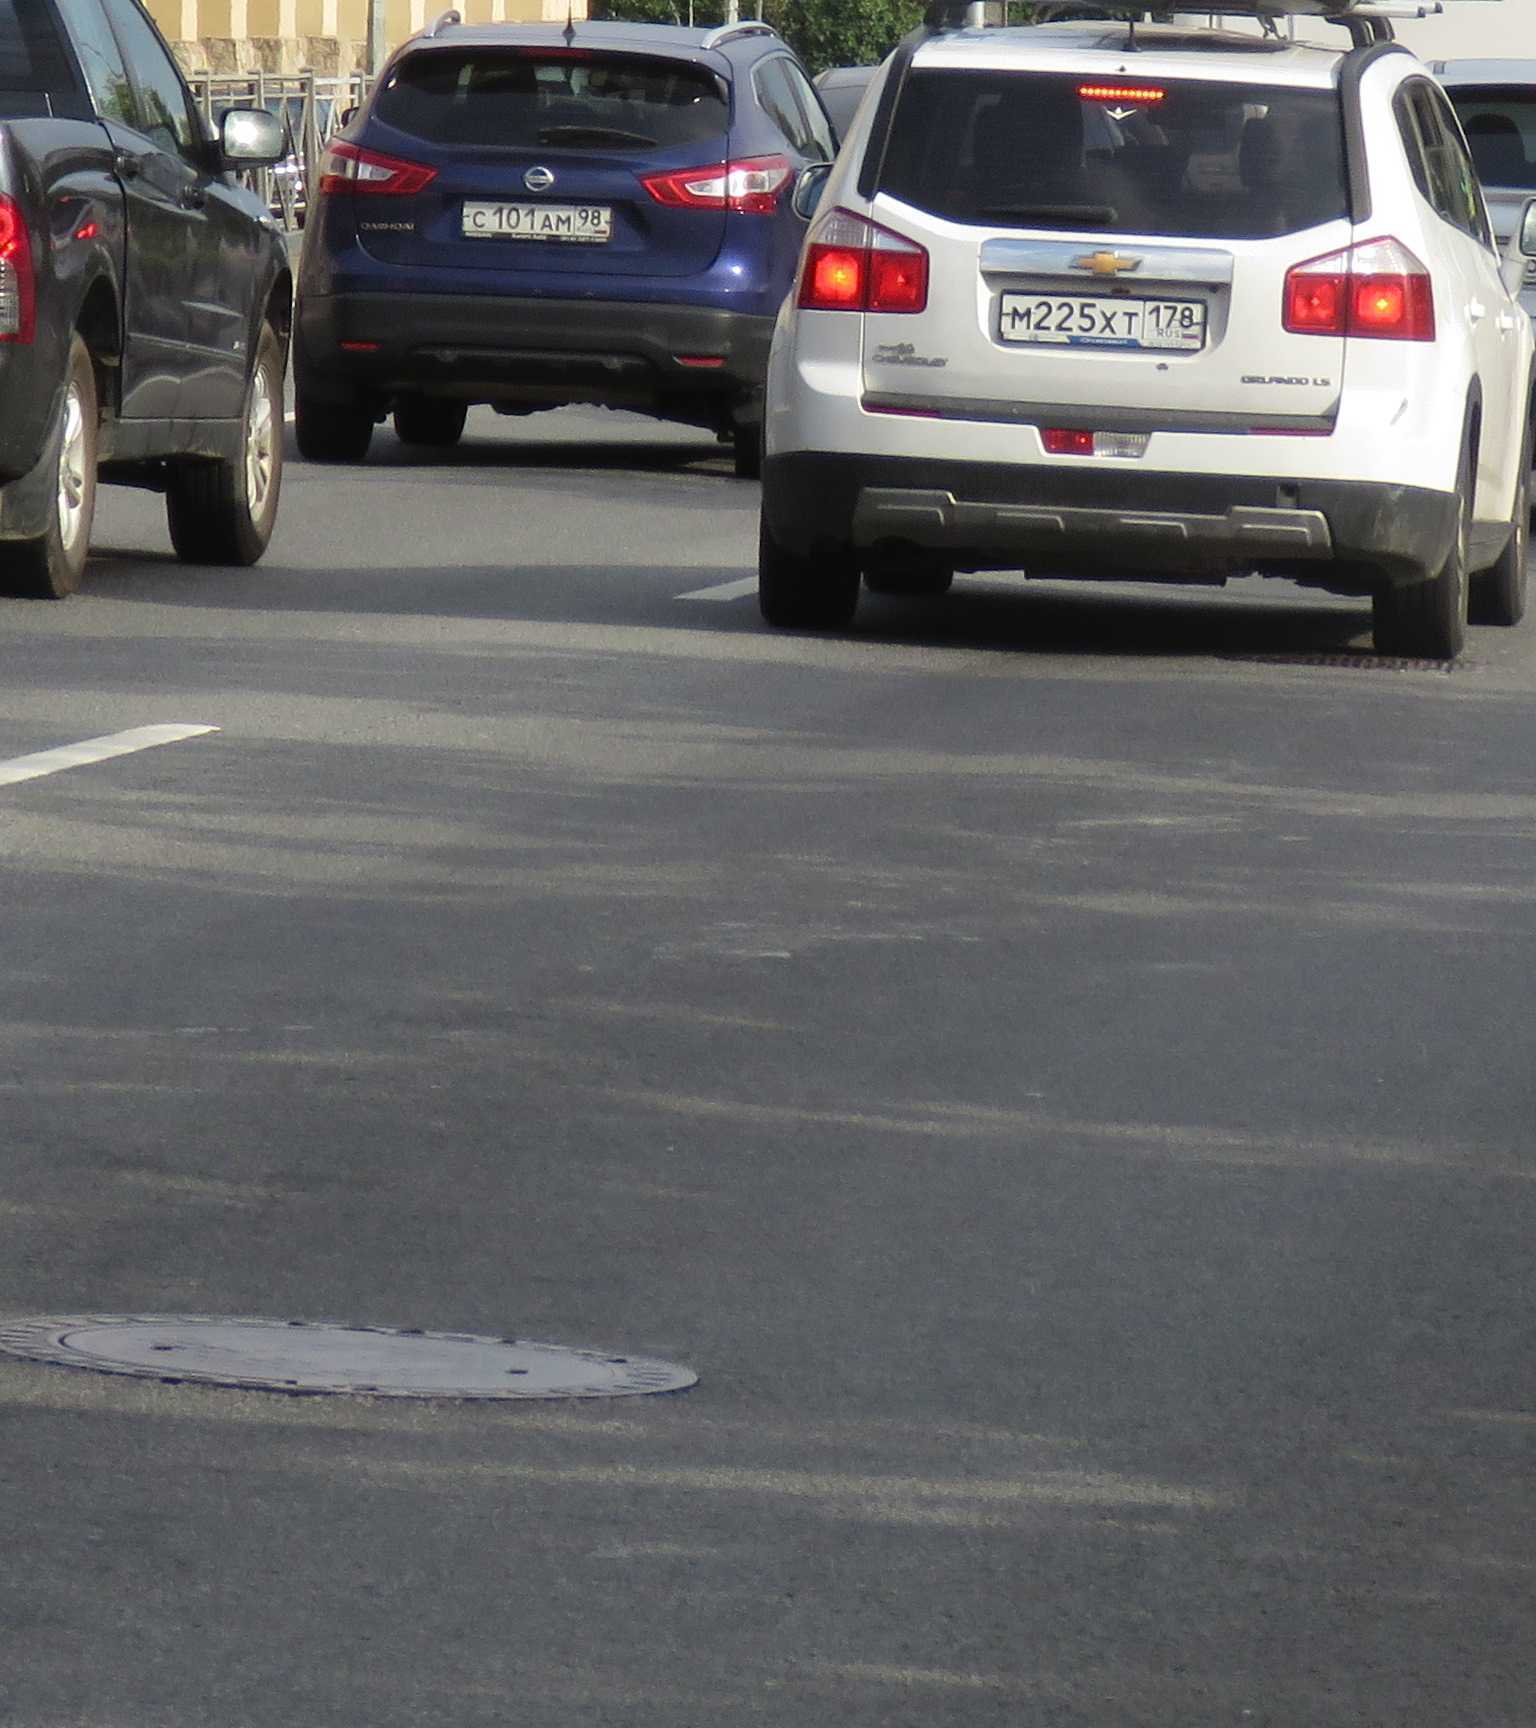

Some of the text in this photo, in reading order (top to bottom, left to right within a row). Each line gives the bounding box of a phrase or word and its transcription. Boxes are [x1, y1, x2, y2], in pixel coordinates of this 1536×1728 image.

[577, 209, 602, 226] 98
[1010, 300, 1195, 335] М225ХТ 178
